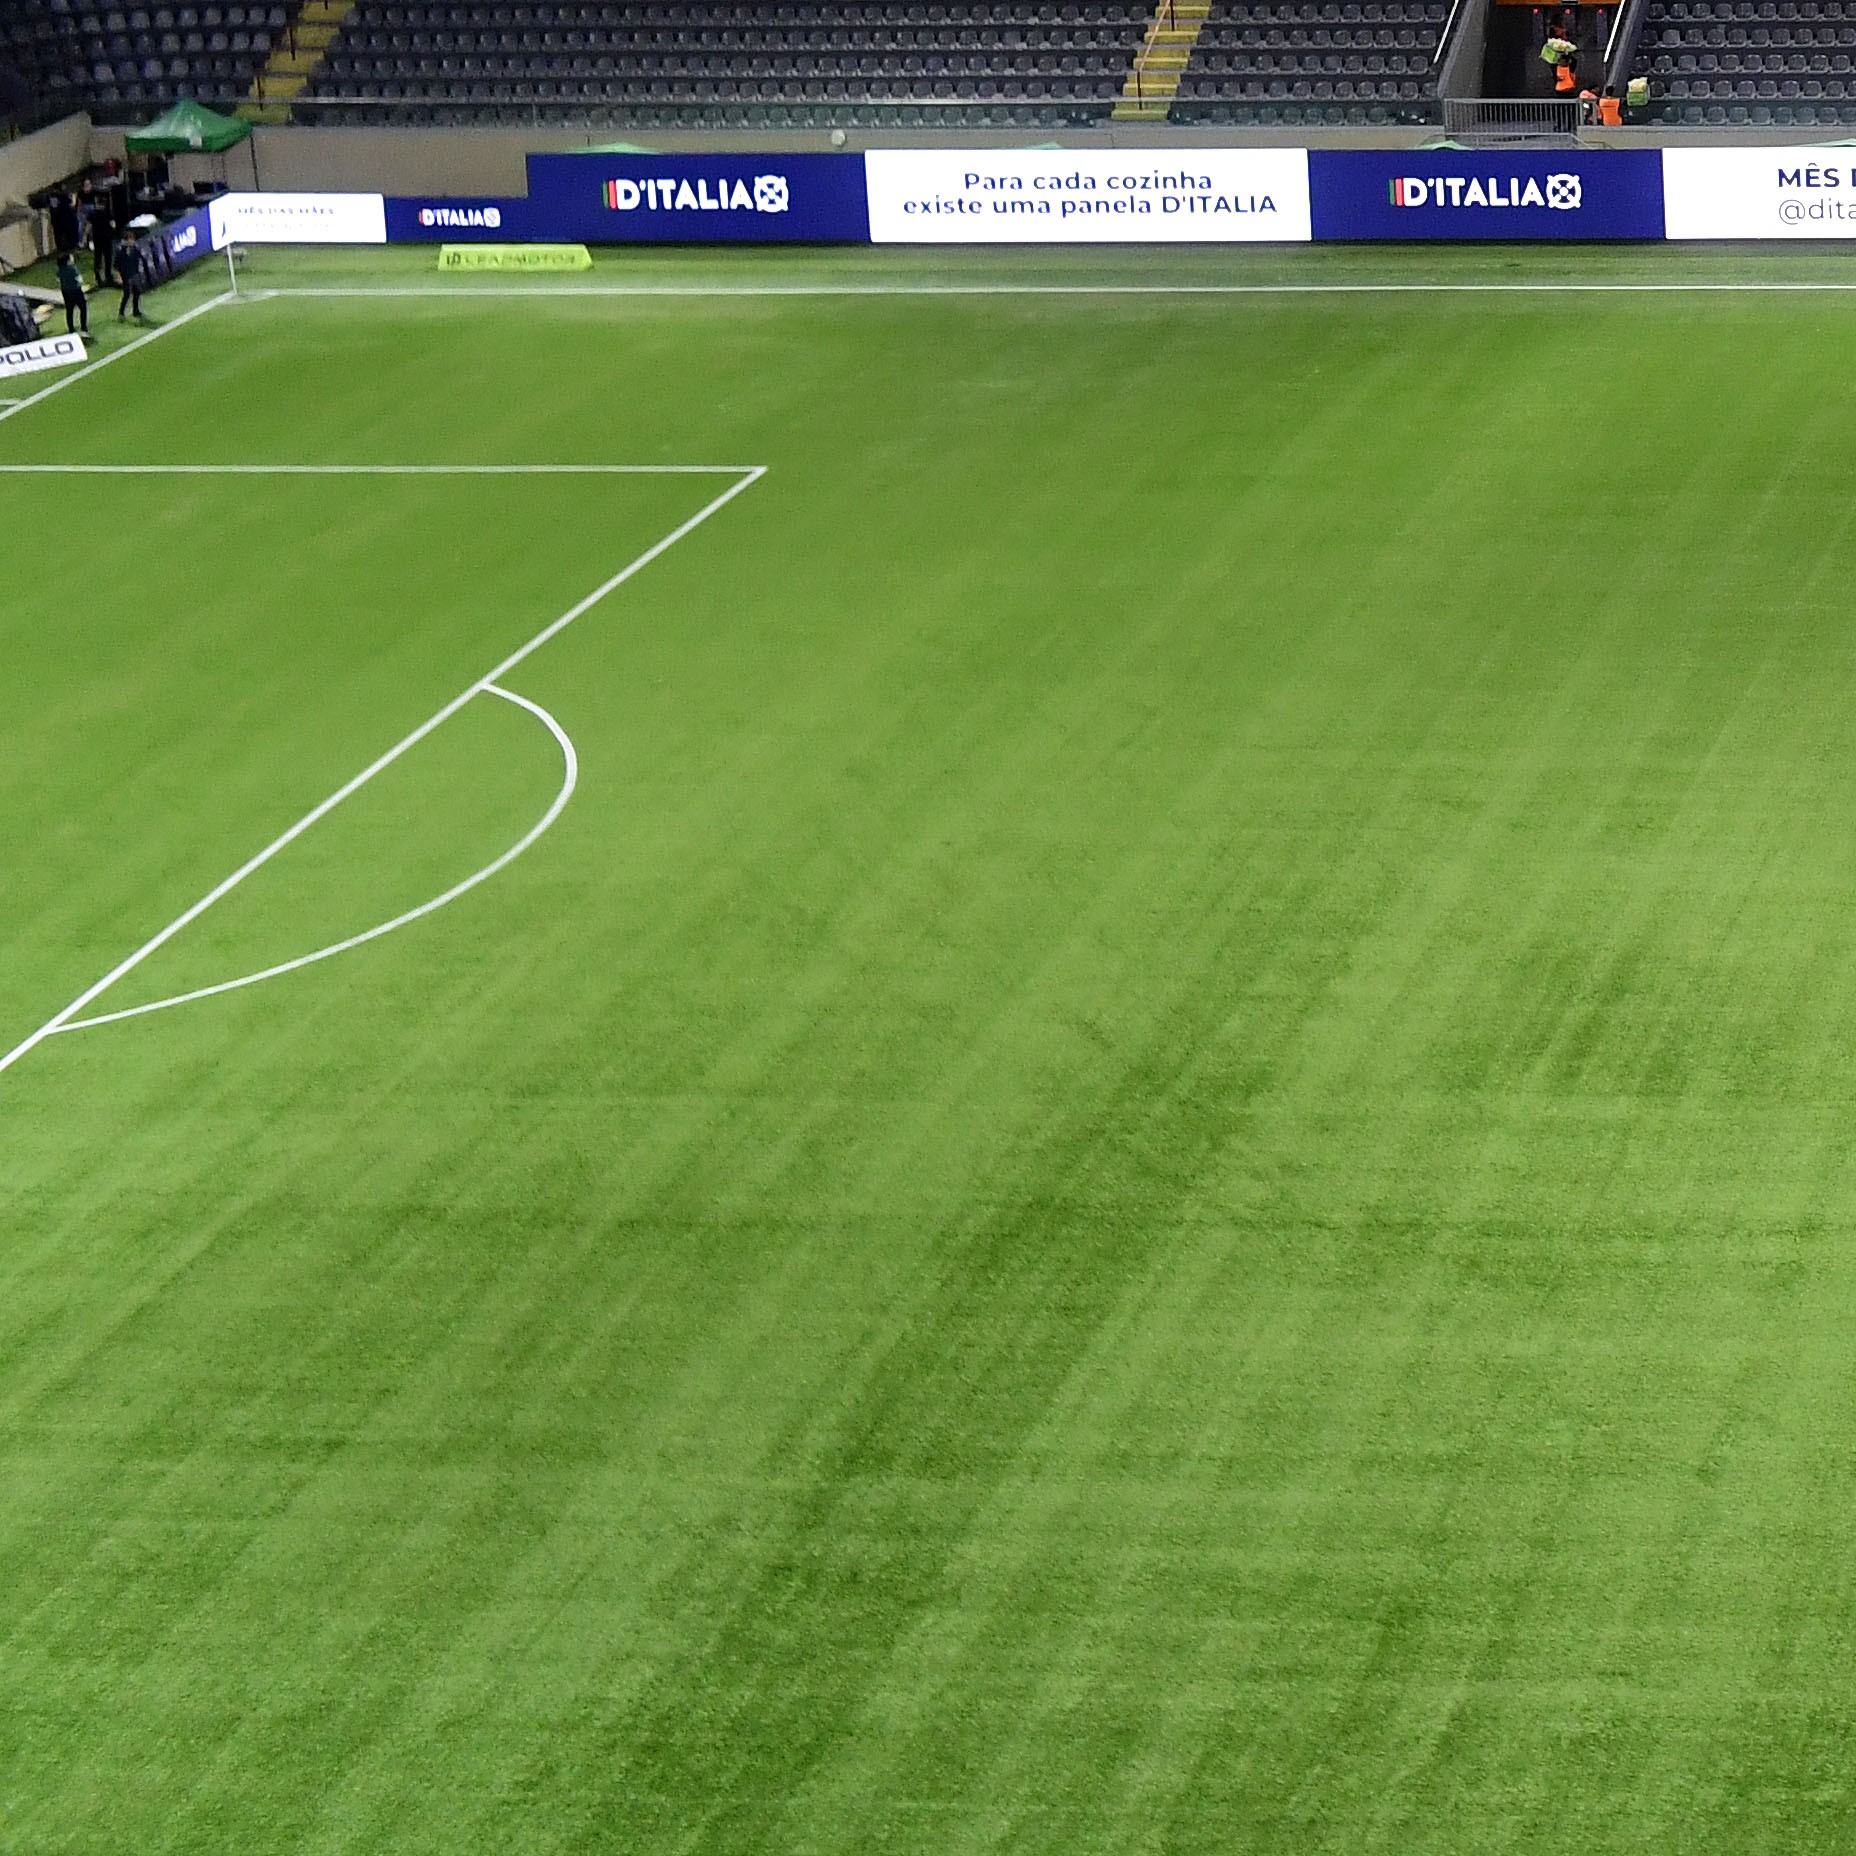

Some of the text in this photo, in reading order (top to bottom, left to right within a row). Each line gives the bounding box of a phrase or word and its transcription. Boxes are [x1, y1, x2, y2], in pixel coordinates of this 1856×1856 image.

[965, 169, 1212, 191] Para cada cozinha
[1778, 162, 1841, 188] MÊS
[616, 178, 755, 210] D'ITALIA
[1403, 177, 1546, 207] D'ITALIA
[904, 194, 1278, 219] existe uma panela D'ITALIA
